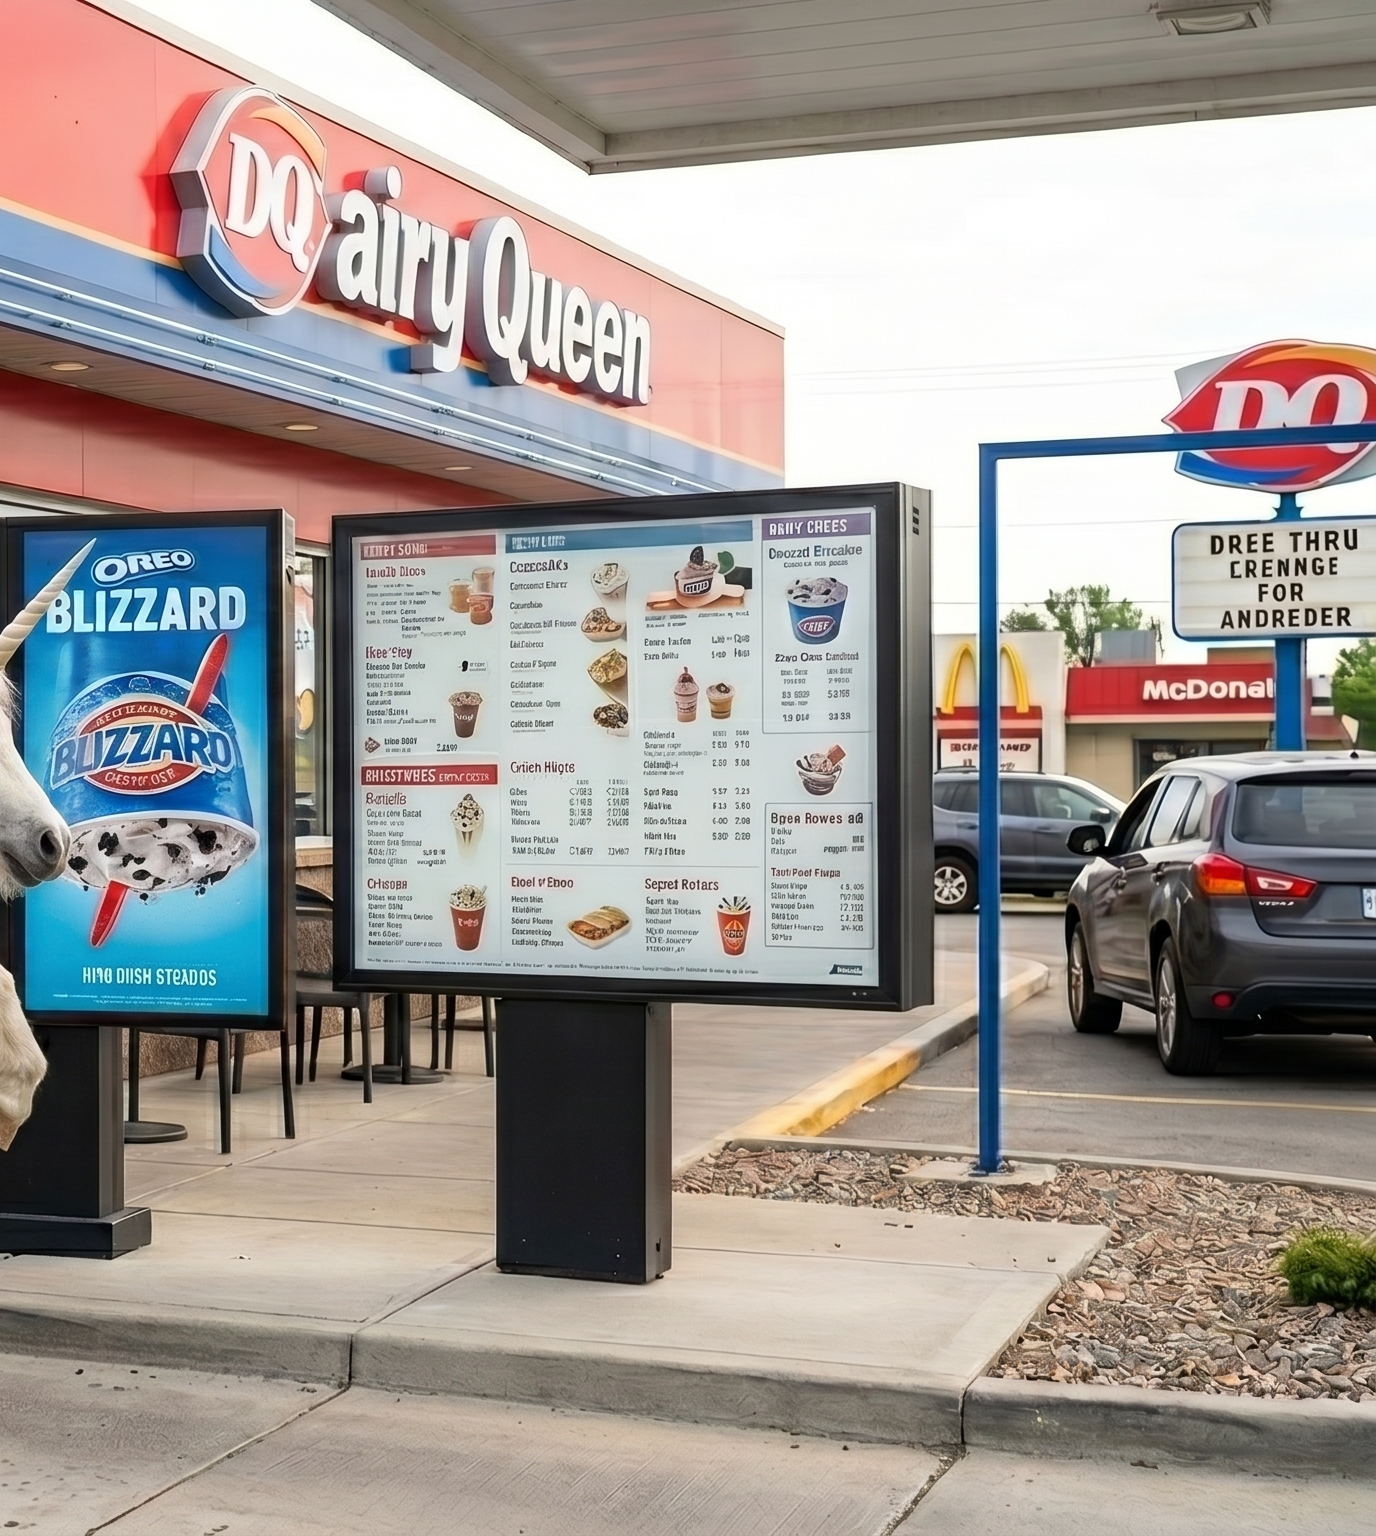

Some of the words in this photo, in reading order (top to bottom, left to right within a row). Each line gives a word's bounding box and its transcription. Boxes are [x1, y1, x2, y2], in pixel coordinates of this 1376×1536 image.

[225, 133, 316, 274] DQ
[334, 166, 470, 373] airy
[479, 215, 652, 406] Queen
[1214, 373, 1369, 455] DQ
[1210, 532, 1275, 556] DREE
[1289, 528, 1359, 552] THRU
[94, 550, 192, 583] OREO
[1257, 582, 1304, 604] FOR
[46, 586, 247, 634] BLIZZARD
[1219, 606, 1352, 630] ANDREDER
[1142, 678, 1276, 701] McDonal
